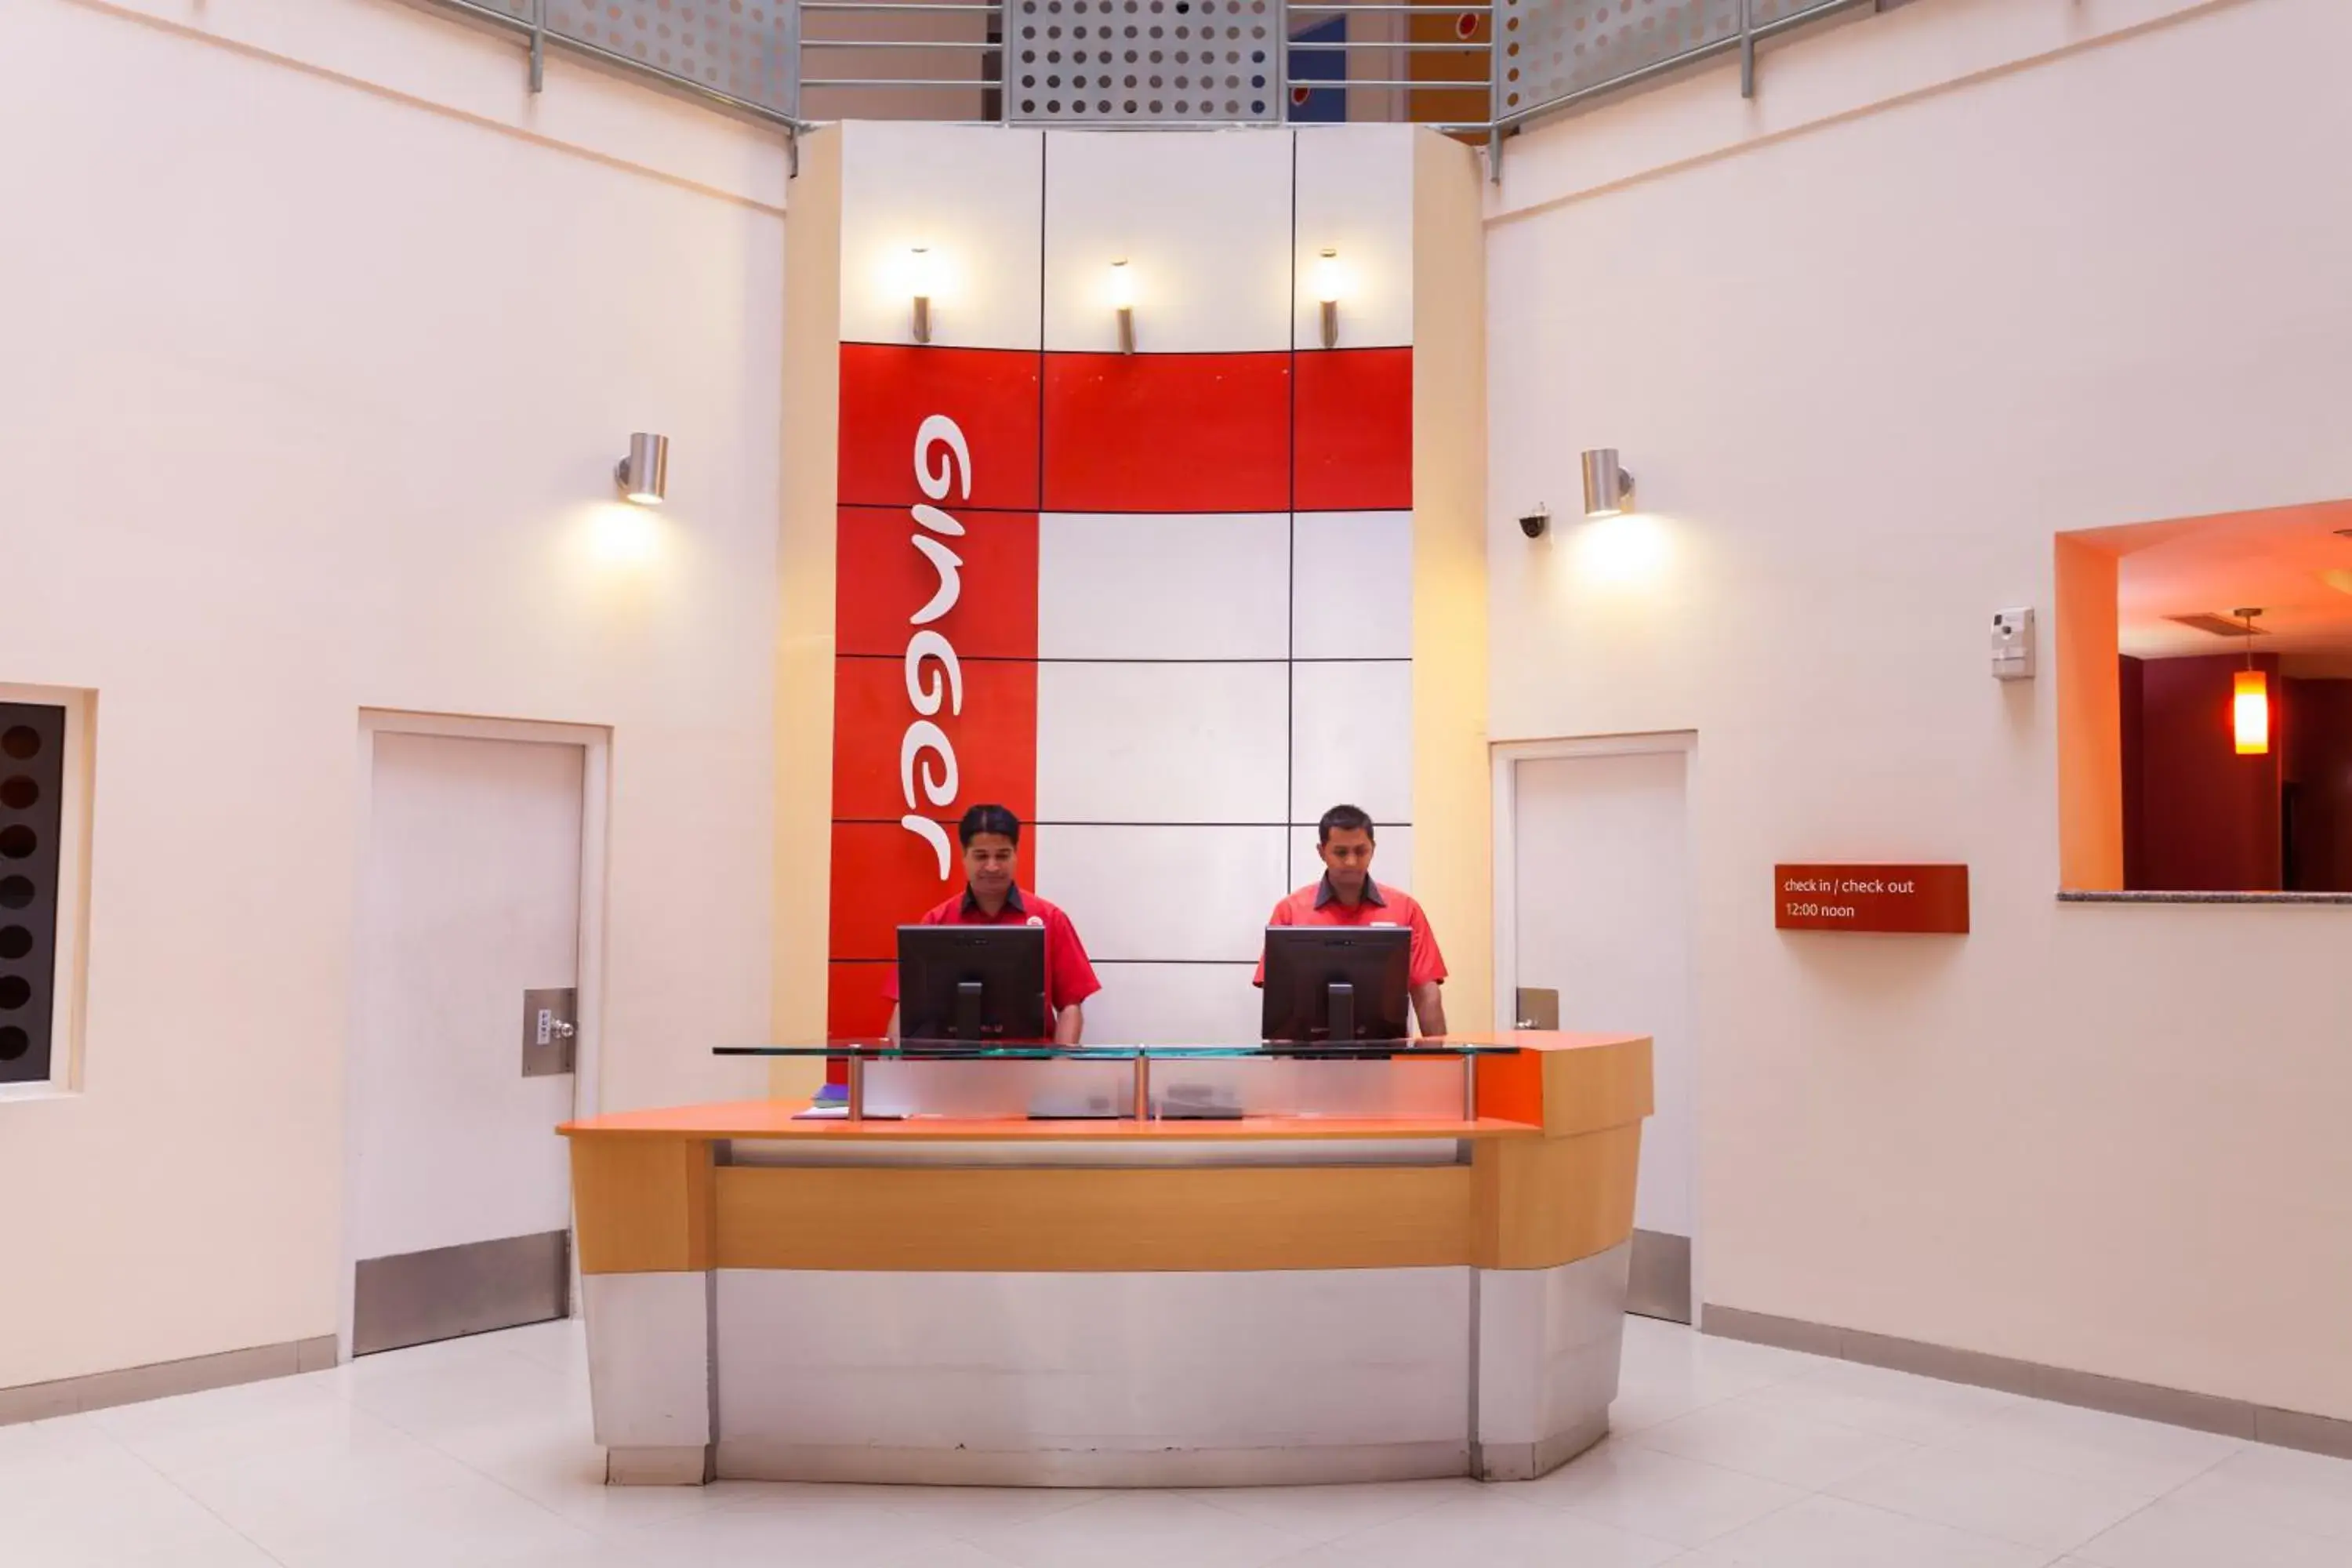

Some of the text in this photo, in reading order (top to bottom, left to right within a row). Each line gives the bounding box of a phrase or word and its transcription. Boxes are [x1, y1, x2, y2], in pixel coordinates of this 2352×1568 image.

[1784, 878, 1915, 896] check in / check out
[1786, 902, 1854, 917] 12:00 noon
